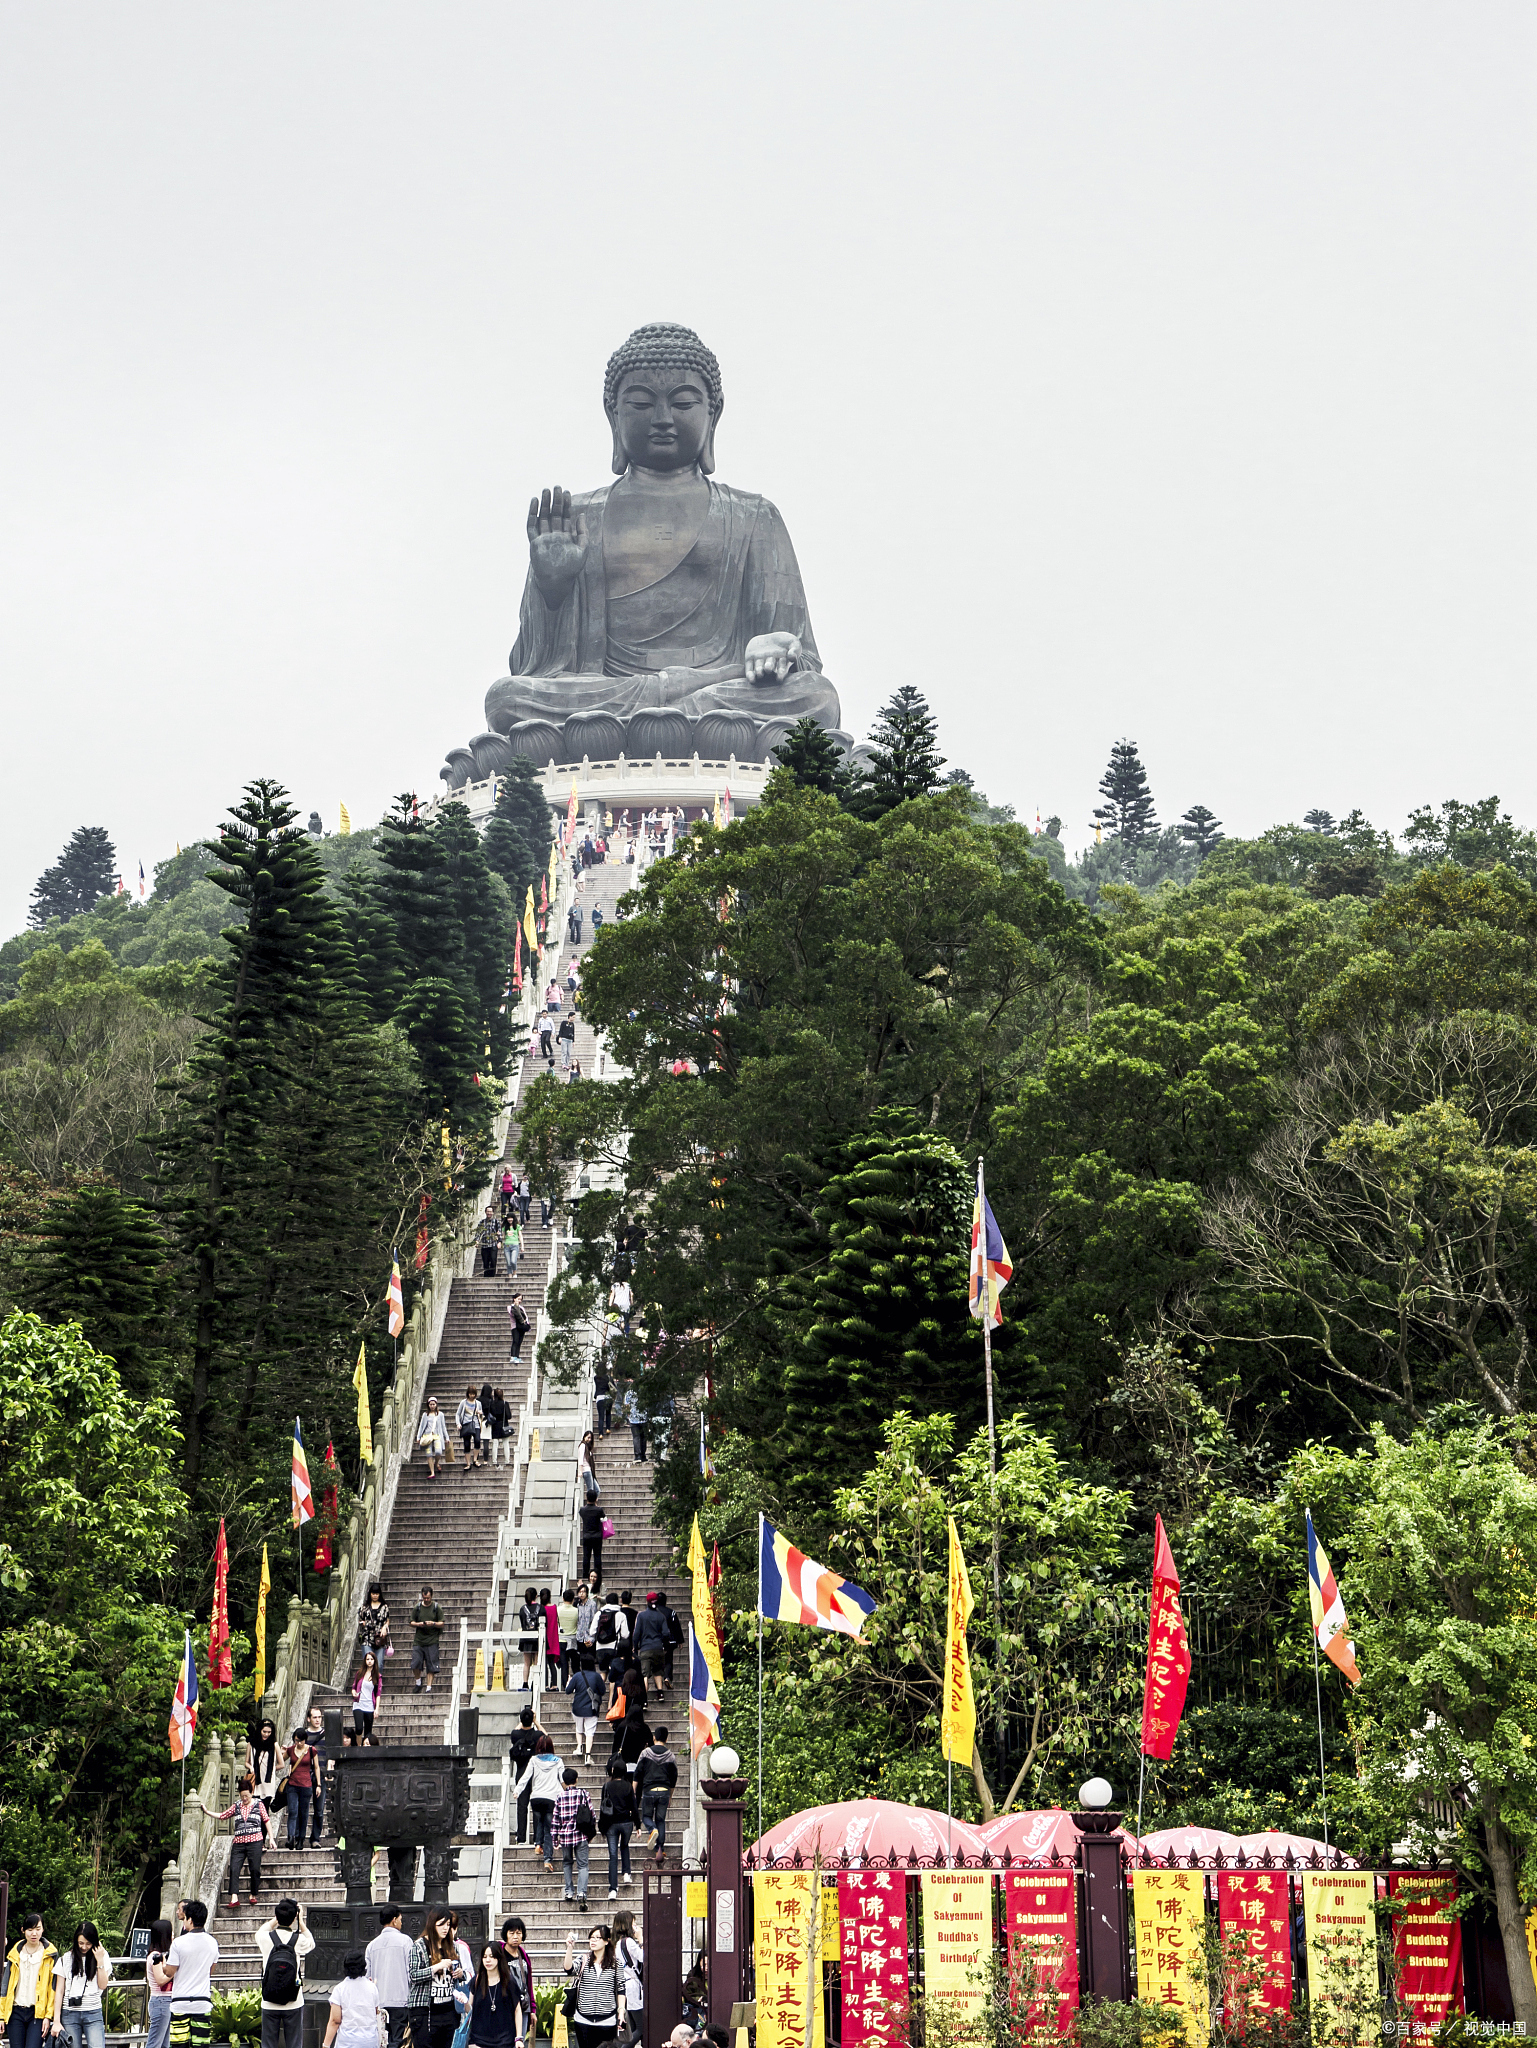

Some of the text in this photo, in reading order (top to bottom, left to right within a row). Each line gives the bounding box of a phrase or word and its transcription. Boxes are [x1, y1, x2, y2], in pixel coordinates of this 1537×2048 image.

[930, 1873, 984, 1885] Celebration
[1013, 1876, 1068, 1888] Celebration
[1311, 1876, 1367, 1889] Celebration
[952, 1892, 962, 1903] Of
[1035, 1893, 1046, 1906] Of
[1334, 1895, 1344, 1906] Of
[933, 1910, 983, 1922] Sakyamuni
[1016, 1912, 1068, 1924] Sakyamuni
[1315, 1913, 1366, 1925] Sakyamuni
[937, 1931, 979, 1942] Buddha's
[1405, 1933, 1449, 1946] Buddha's
[940, 1952, 978, 1964] Birthday
[1409, 1955, 1449, 1967] Birthday
[934, 1989, 953, 1998] Lunar
[1404, 1992, 1425, 2002] Lunar
[1422, 2003, 1442, 2013] 1-8/4
